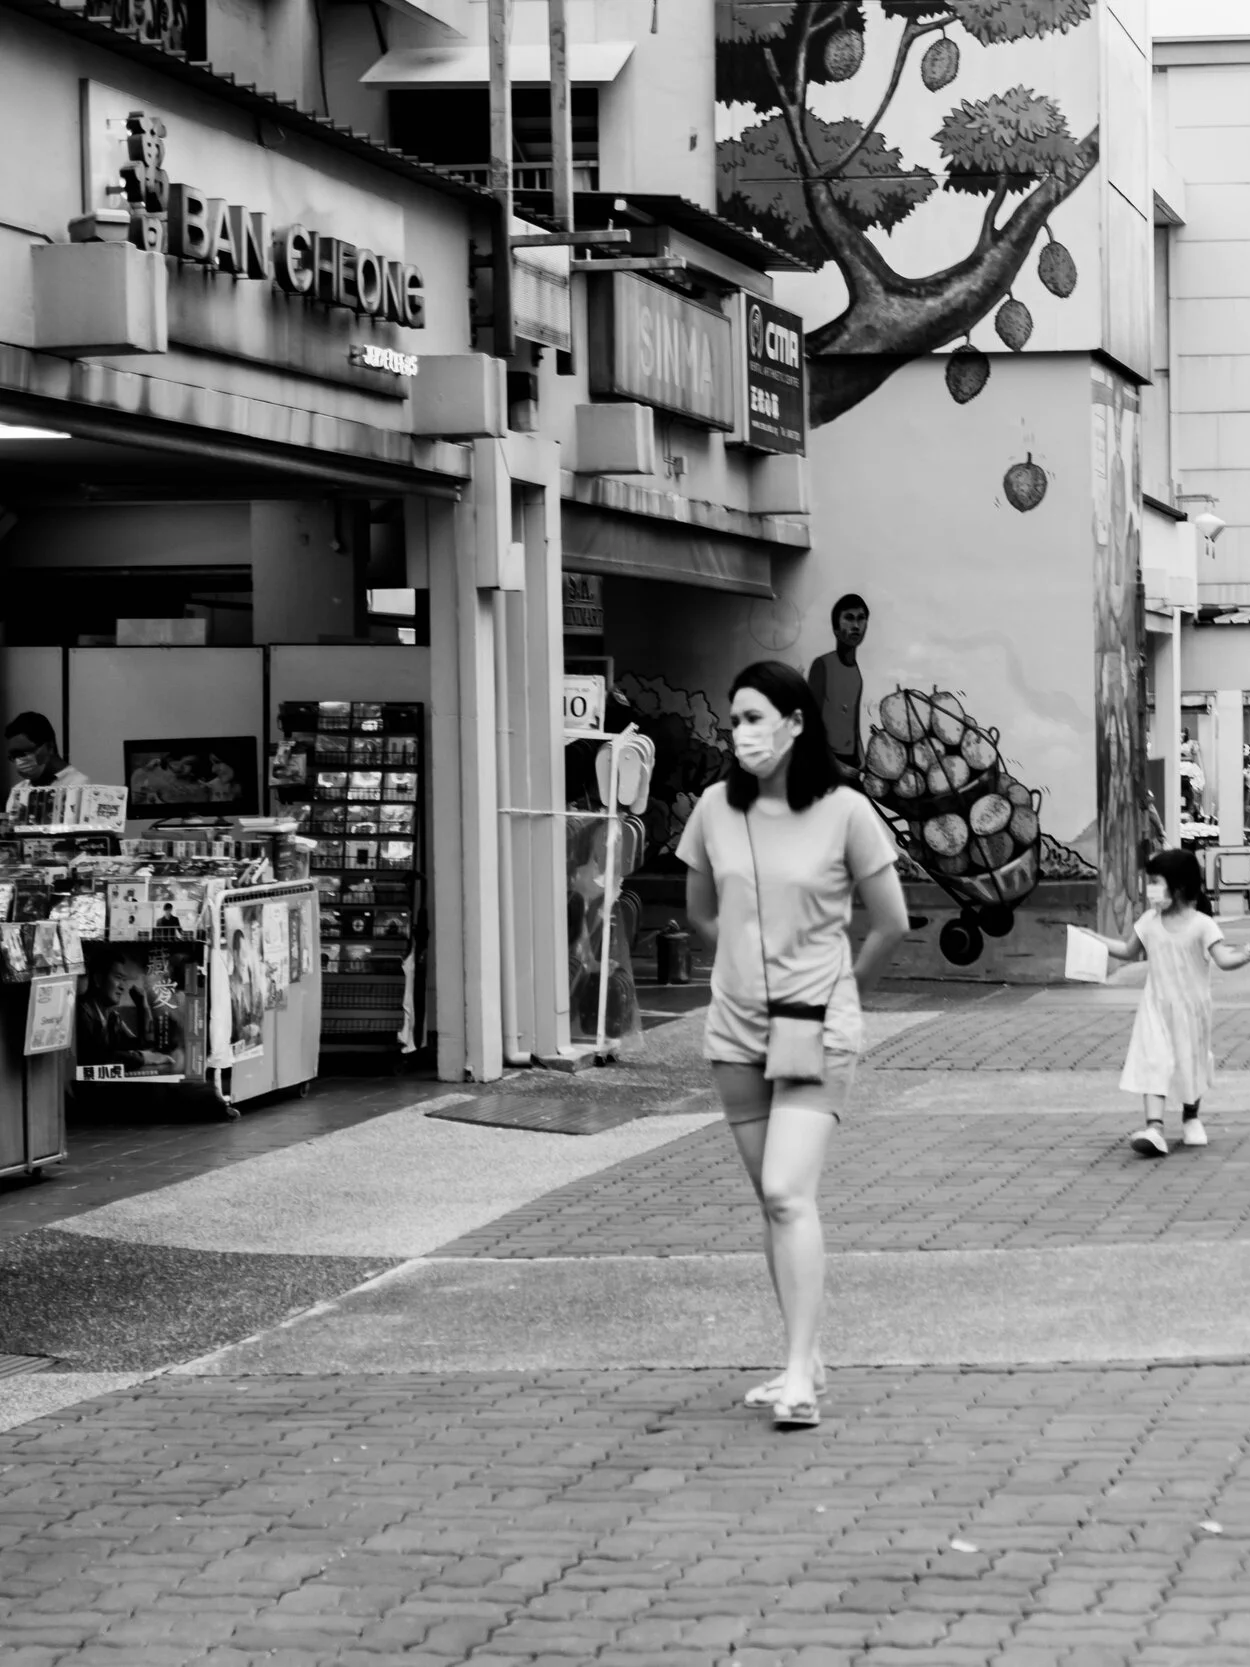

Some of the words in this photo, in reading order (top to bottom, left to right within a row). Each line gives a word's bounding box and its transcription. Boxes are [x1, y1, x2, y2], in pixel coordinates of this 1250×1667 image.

[169, 183, 271, 279] BAN
[275, 224, 425, 329] CHEONG
[640, 305, 715, 396] SINMA
